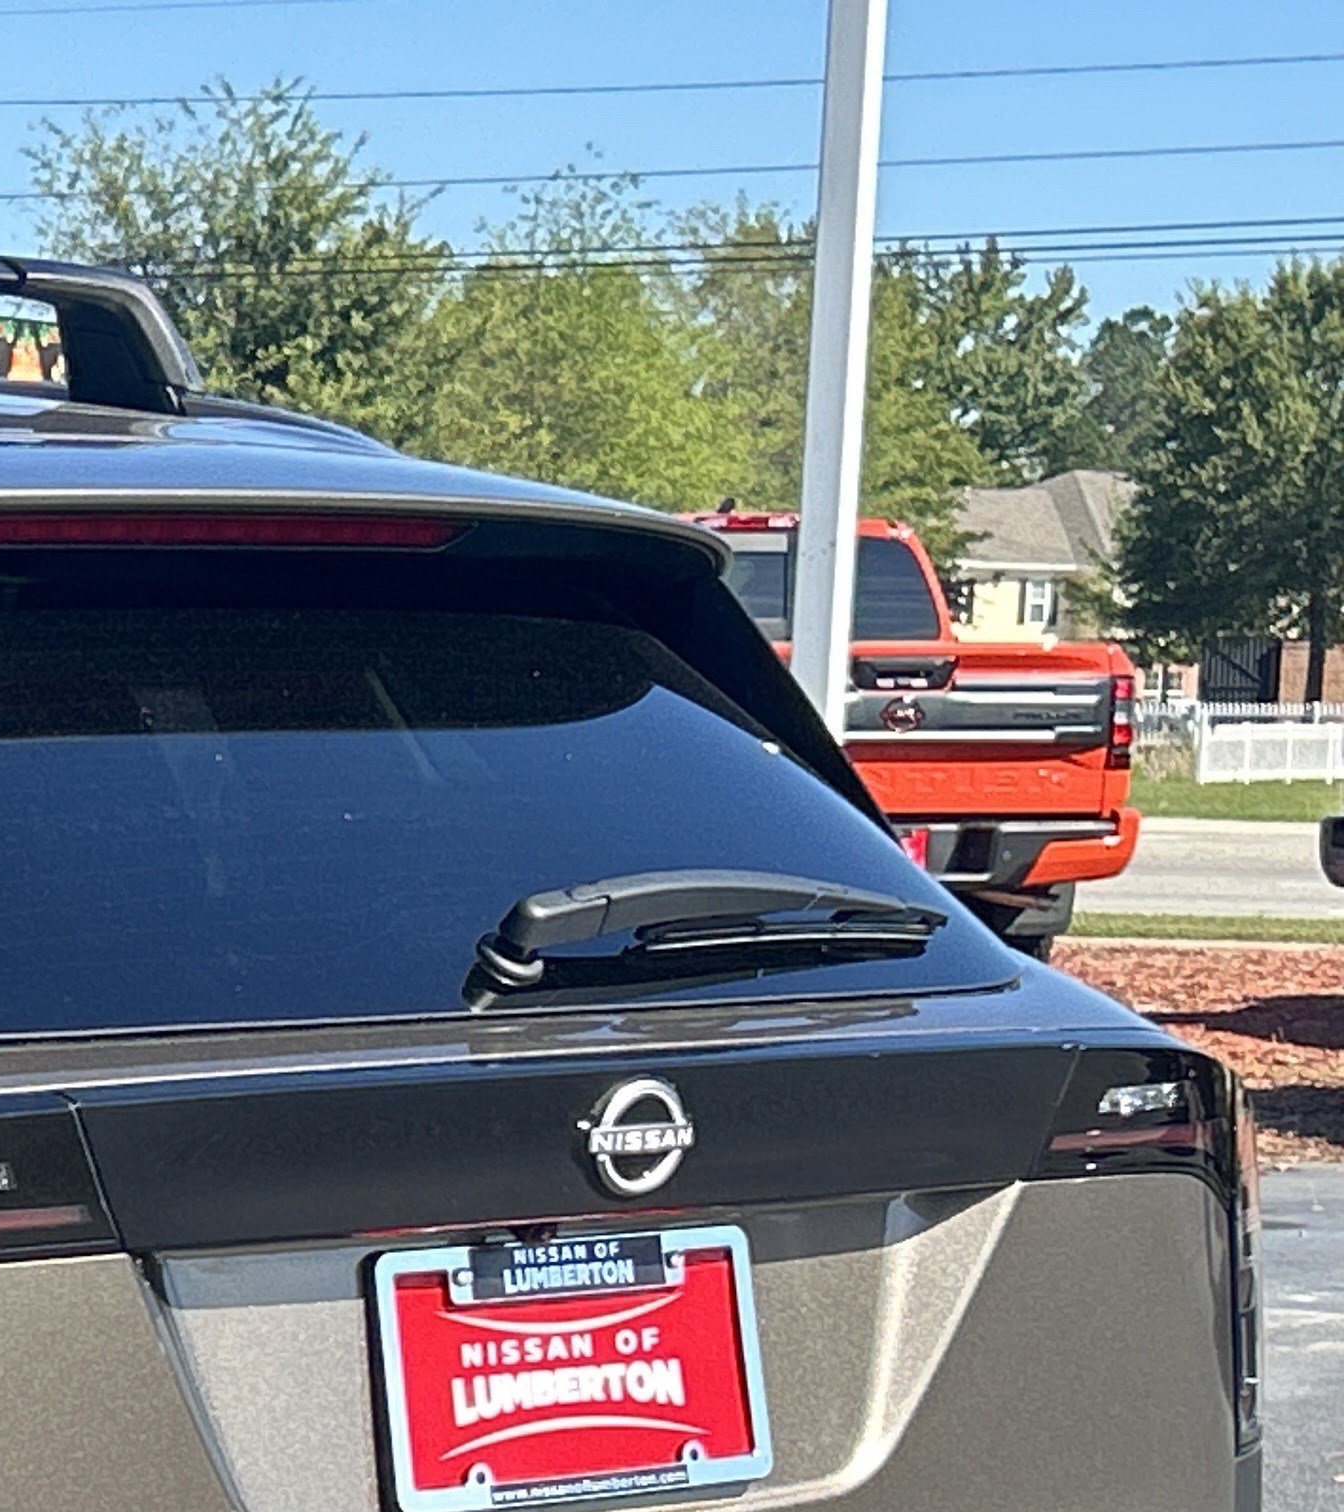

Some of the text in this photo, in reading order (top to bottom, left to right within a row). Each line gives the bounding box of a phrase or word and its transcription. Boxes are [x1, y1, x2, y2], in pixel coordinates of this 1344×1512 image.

[591, 1126, 694, 1153] NISSAN
[513, 1241, 620, 1265] NISSAN OF
[503, 1258, 636, 1294] LUMBERTON
[460, 1326, 660, 1368] NISSAN OF
[450, 1357, 686, 1428] LUMBERTON
